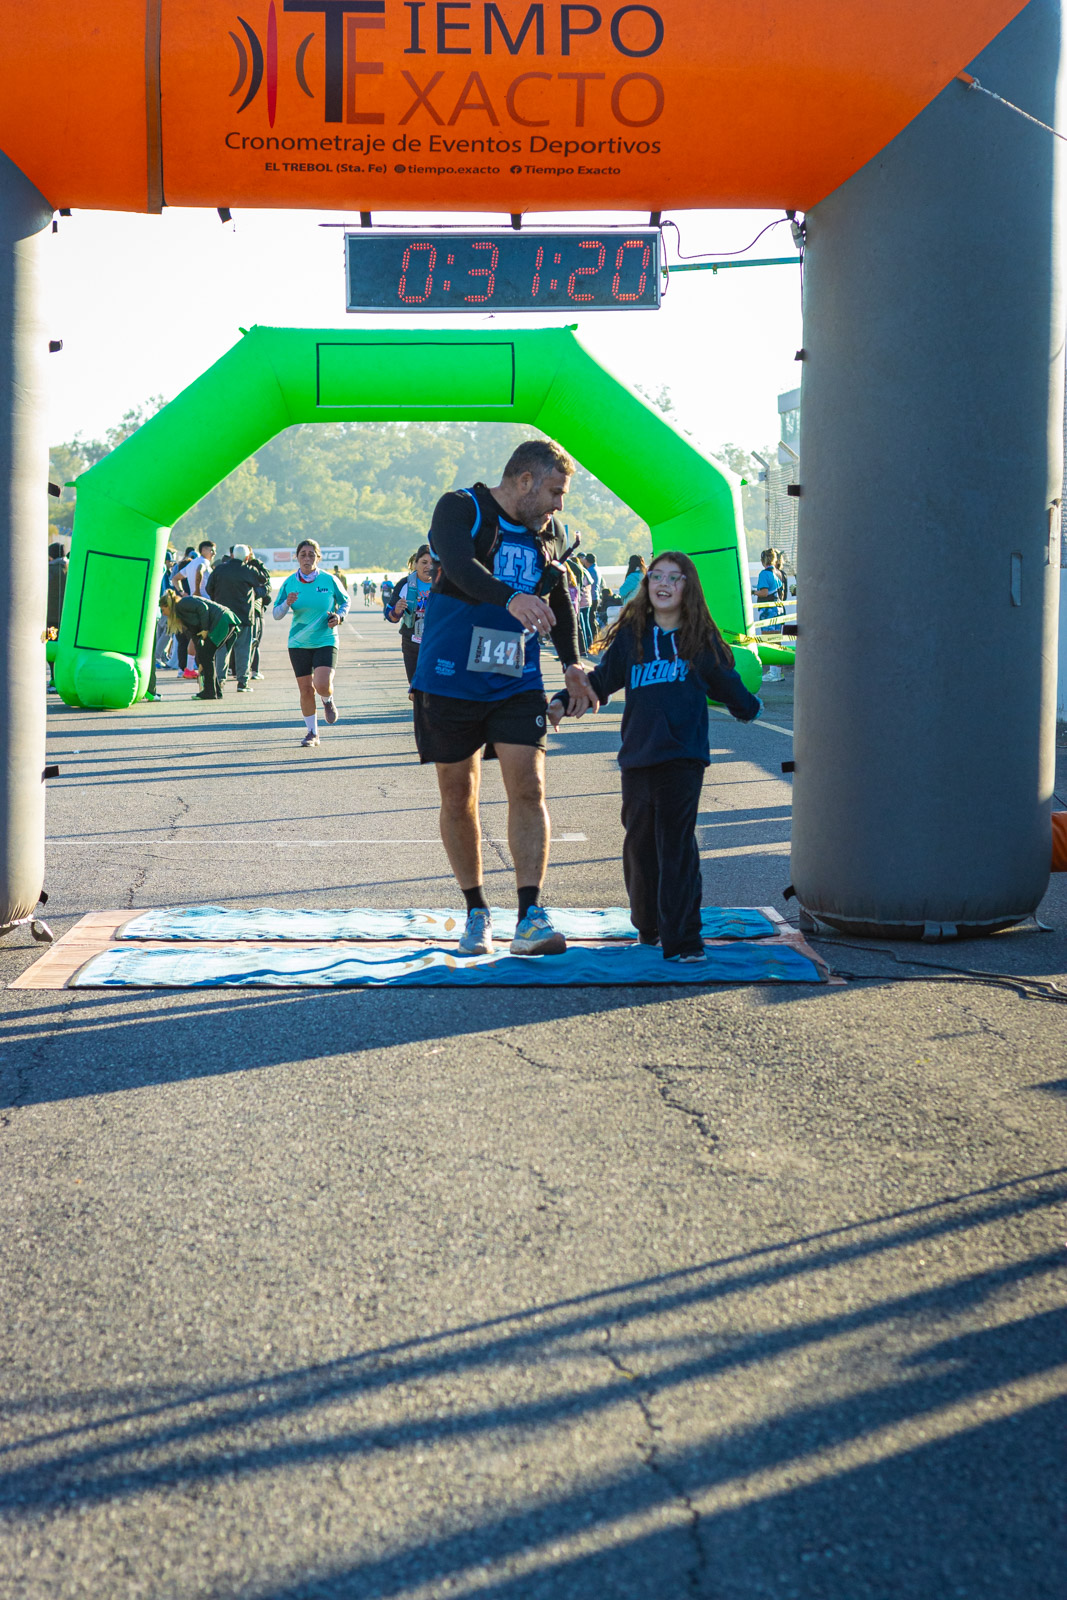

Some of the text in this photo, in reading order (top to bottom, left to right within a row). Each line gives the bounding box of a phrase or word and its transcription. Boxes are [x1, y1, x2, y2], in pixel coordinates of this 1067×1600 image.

[224, 131, 662, 158] Cronometraje de Eventos Deportivos
[265, 162, 280, 171] EL
[282, 163, 333, 173] TREBOL
[336, 163, 365, 174] (Sta.
[367, 164, 388, 174] Fe)
[524, 165, 575, 176] Tiempo
[577, 166, 621, 175] Exacto
[481, 639, 518, 666] 147
